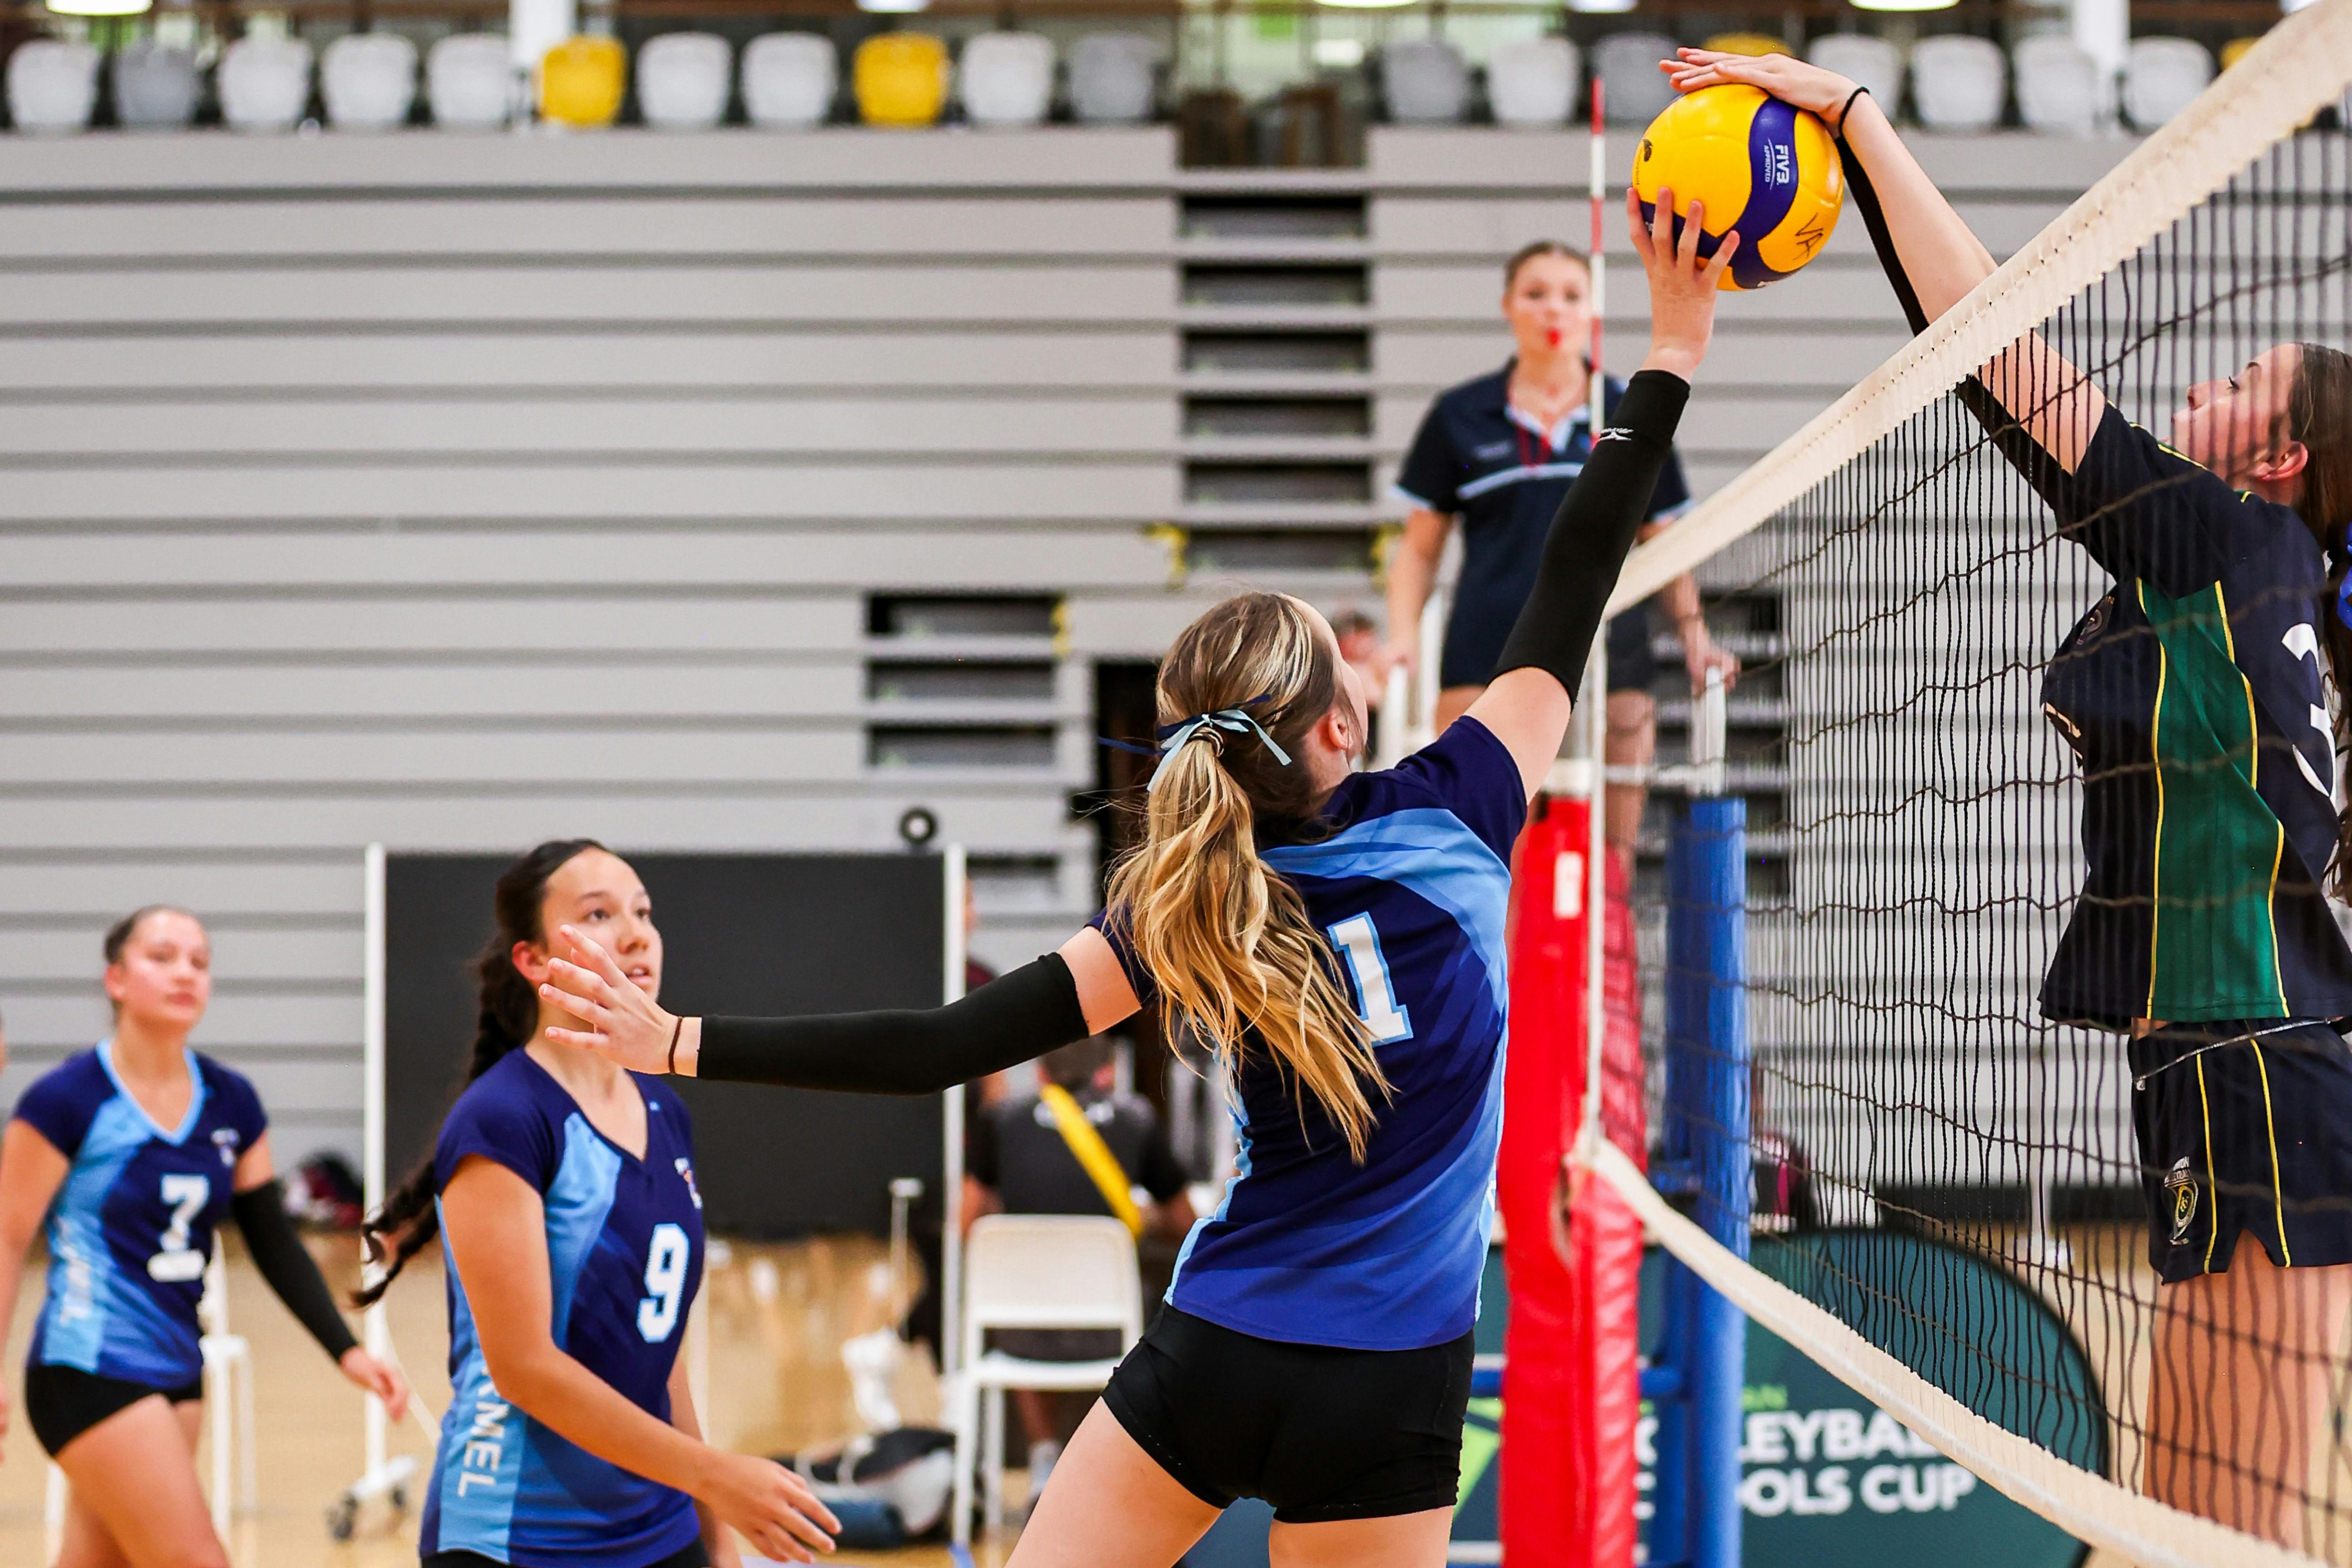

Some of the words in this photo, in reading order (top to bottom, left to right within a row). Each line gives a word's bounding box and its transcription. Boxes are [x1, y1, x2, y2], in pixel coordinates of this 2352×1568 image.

[1326, 911, 1413, 1050] 1
[160, 1173, 209, 1253] 7
[636, 1222, 690, 1343] 9
[1739, 1408, 1943, 1463] EYBAL
[1736, 1467, 1853, 1517] OLS
[1860, 1463, 1976, 1513] CUP
